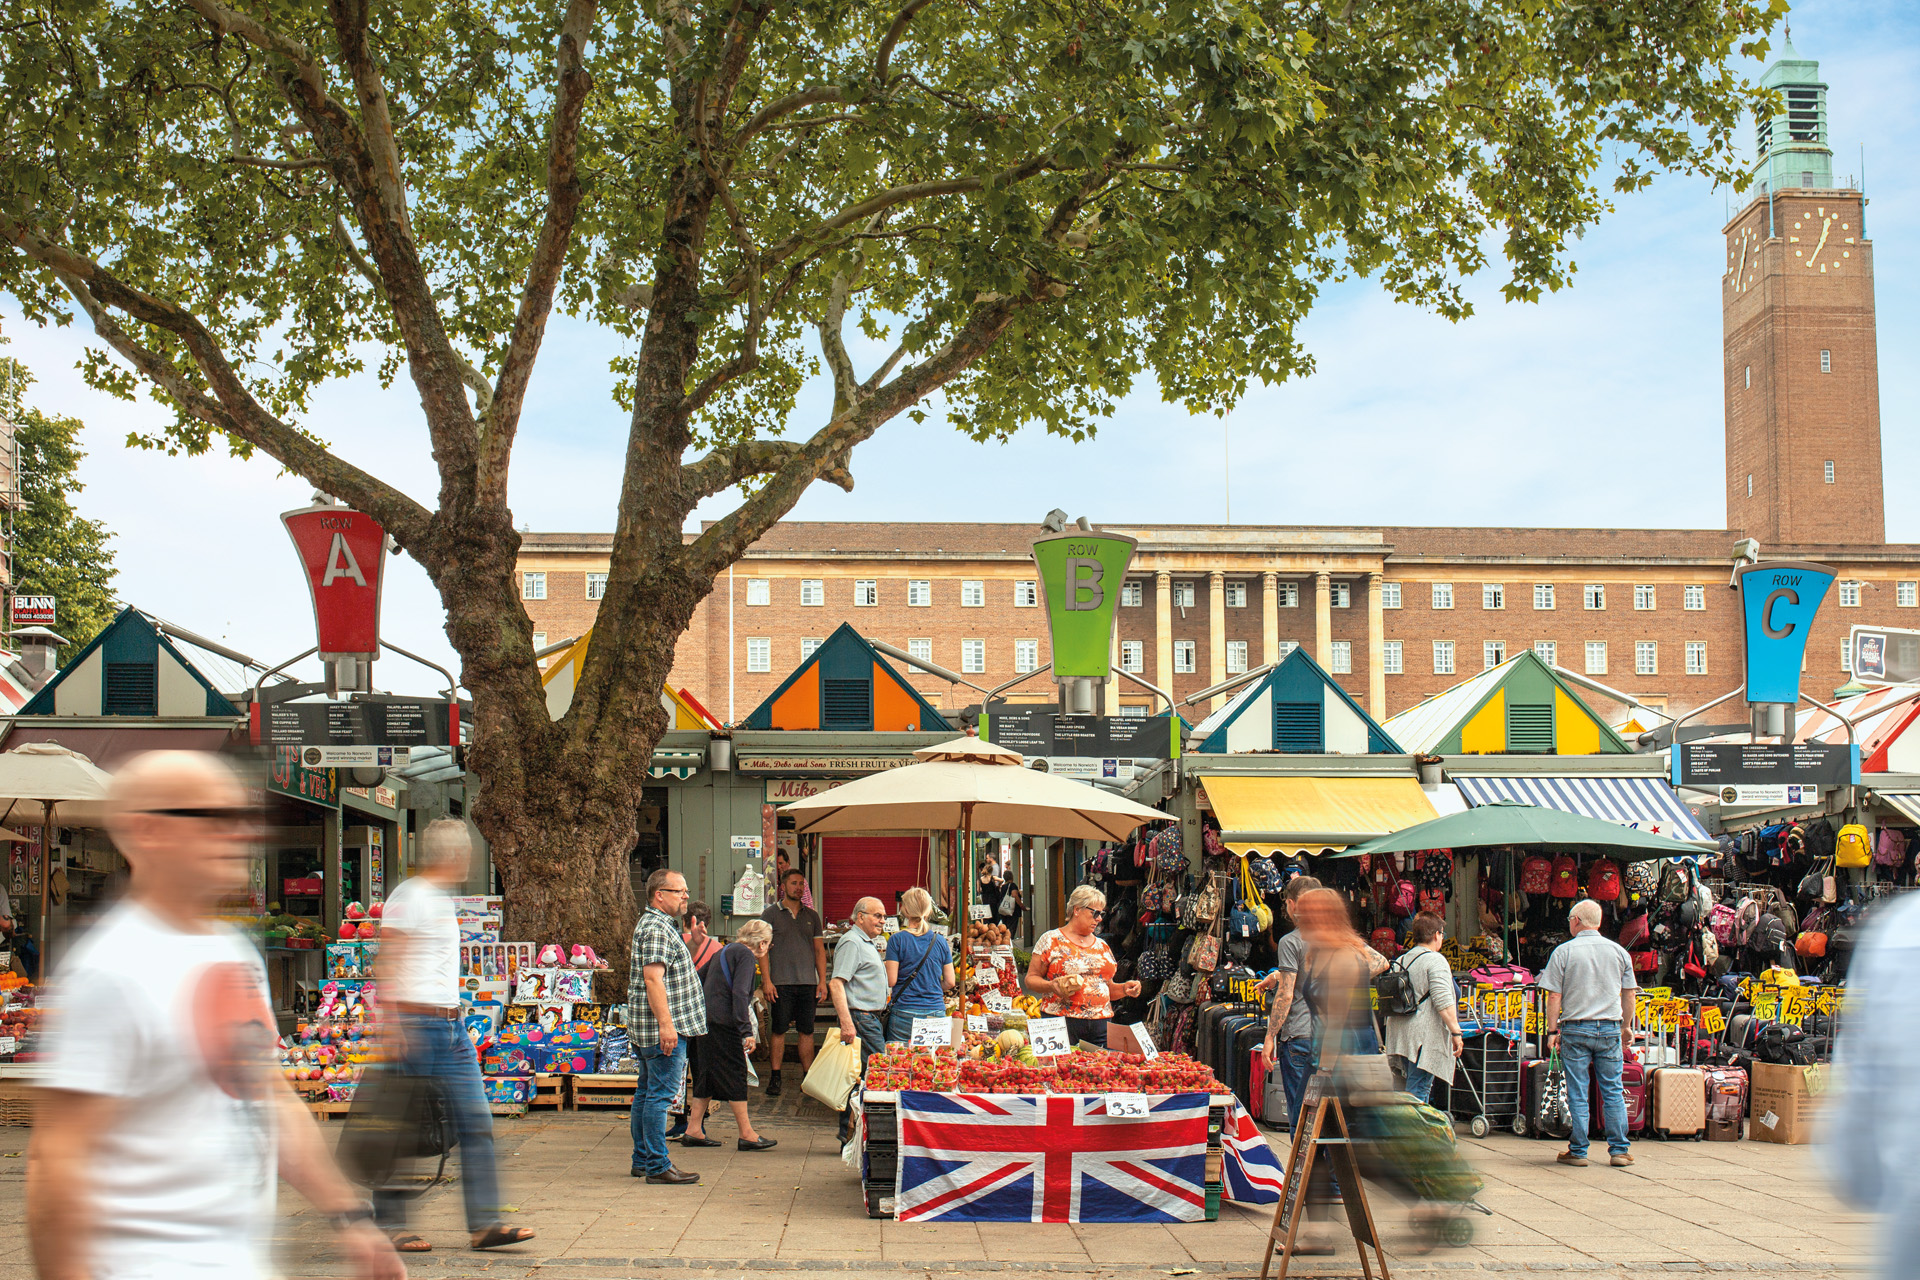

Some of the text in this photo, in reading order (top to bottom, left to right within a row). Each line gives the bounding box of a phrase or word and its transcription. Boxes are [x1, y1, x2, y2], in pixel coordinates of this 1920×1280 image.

[320, 518, 352, 529] ROW
[1068, 544, 1098, 556] ROW
[322, 532, 368, 586] A
[1064, 558, 1104, 611] B
[1772, 574, 1802, 586] ROW
[15, 598, 53, 608] BUNN
[1762, 588, 1800, 640] C
[750, 760, 772, 769] Mike,
[300, 773, 327, 801] & VEG
[14, 846, 22, 892] SALAD
[1708, 1015, 1721, 1032] 15
